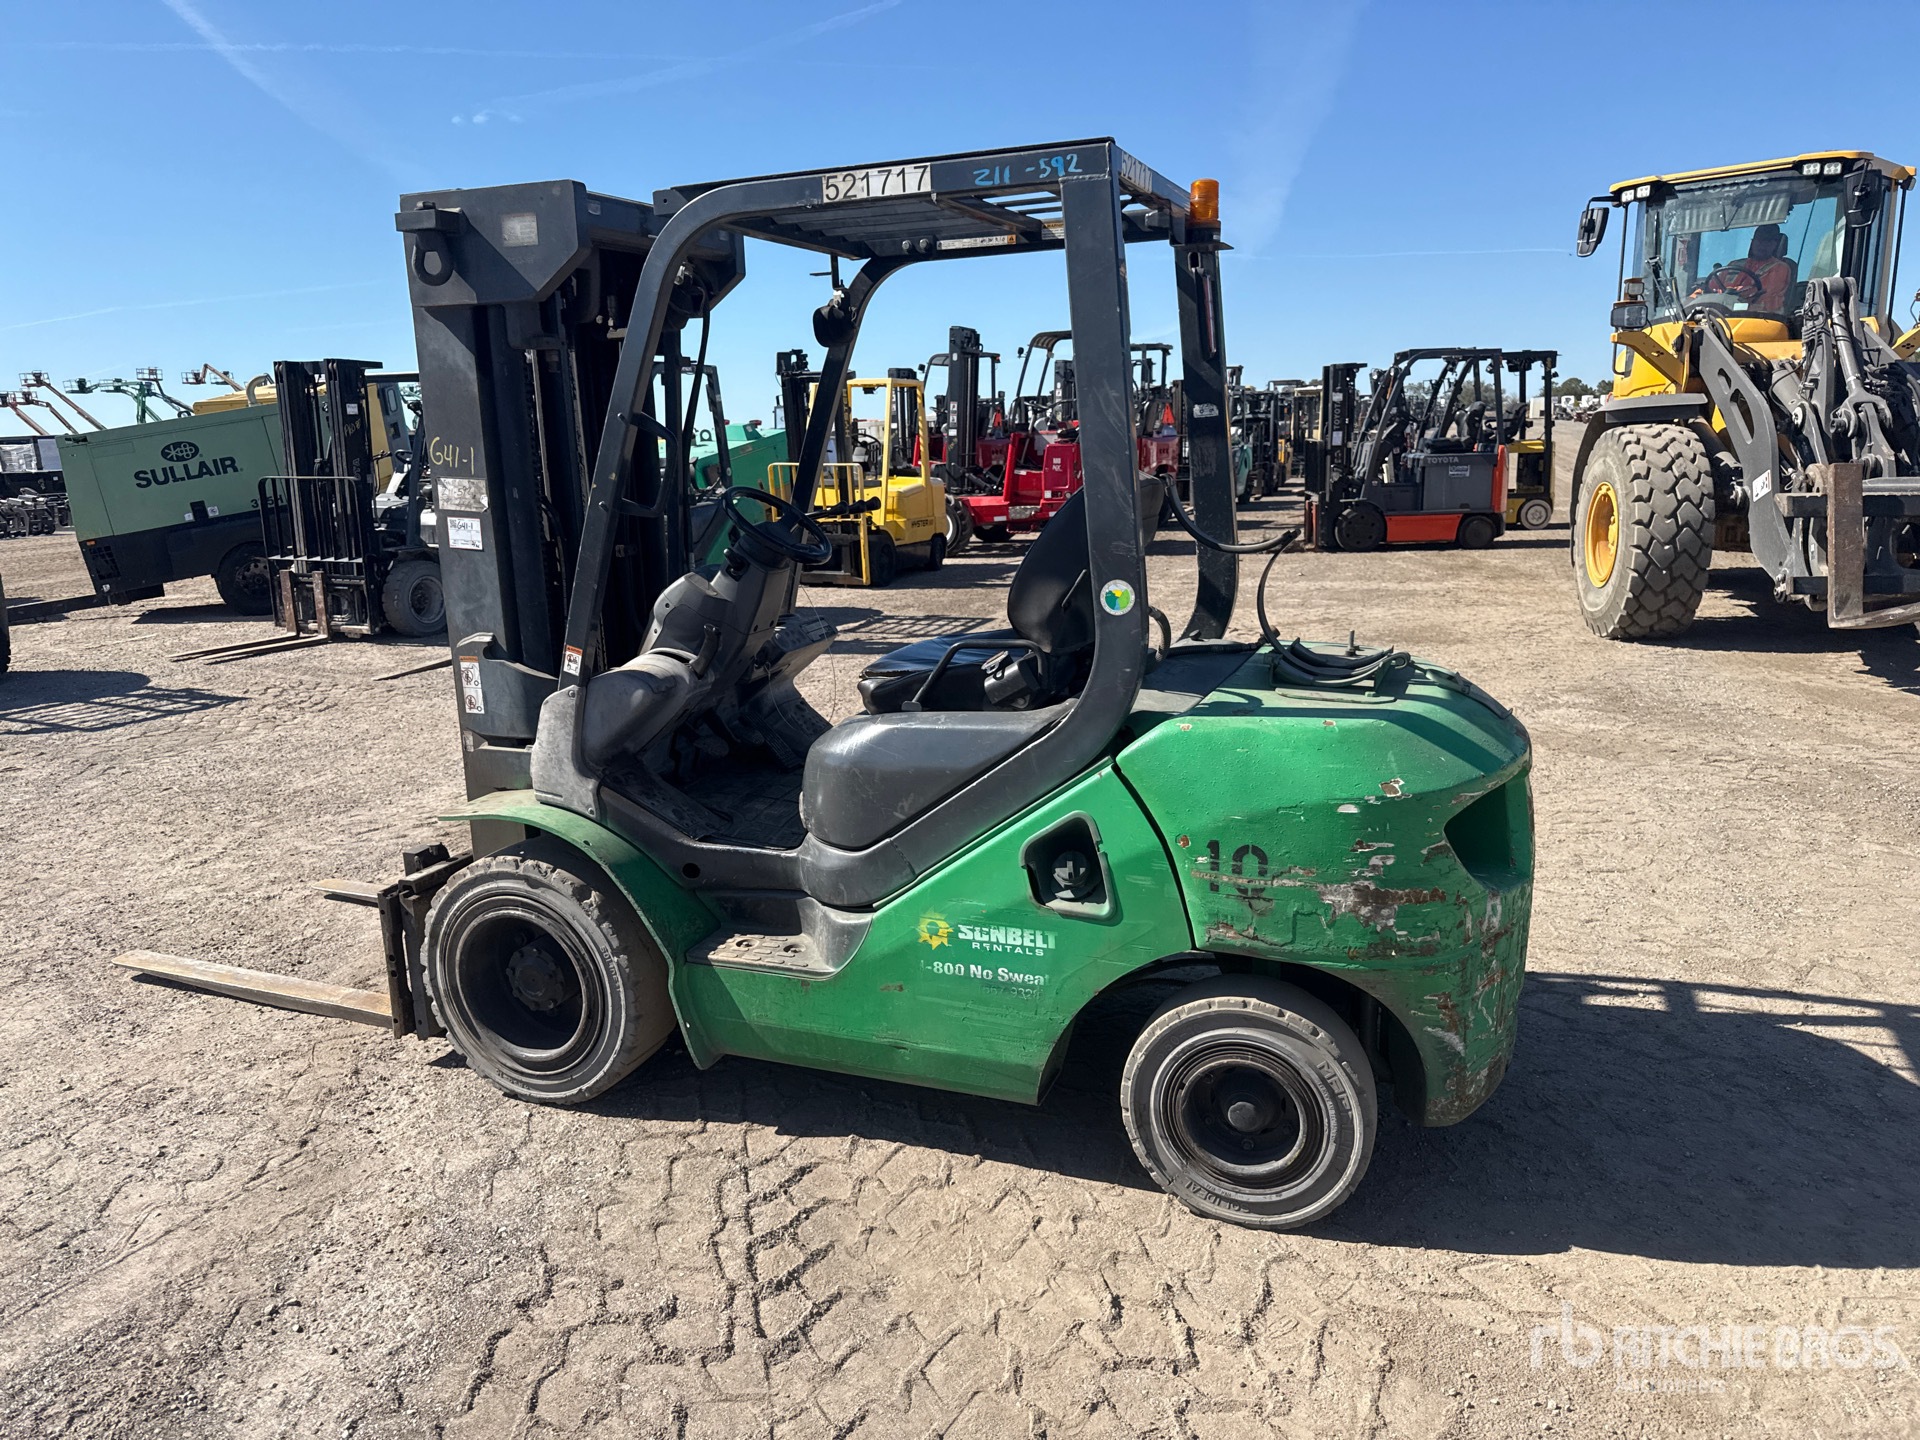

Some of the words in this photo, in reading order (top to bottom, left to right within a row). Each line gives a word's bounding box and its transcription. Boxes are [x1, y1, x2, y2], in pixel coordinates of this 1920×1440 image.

[825, 165, 928, 200] 521717
[430, 436, 475, 475] G41-1
[1427, 456, 1459, 464] TOYOTA
[134, 456, 239, 488] SULLAIR
[1206, 840, 1268, 896] 10
[958, 924, 1058, 949] SUNBELT
[970, 964, 993, 980] No
